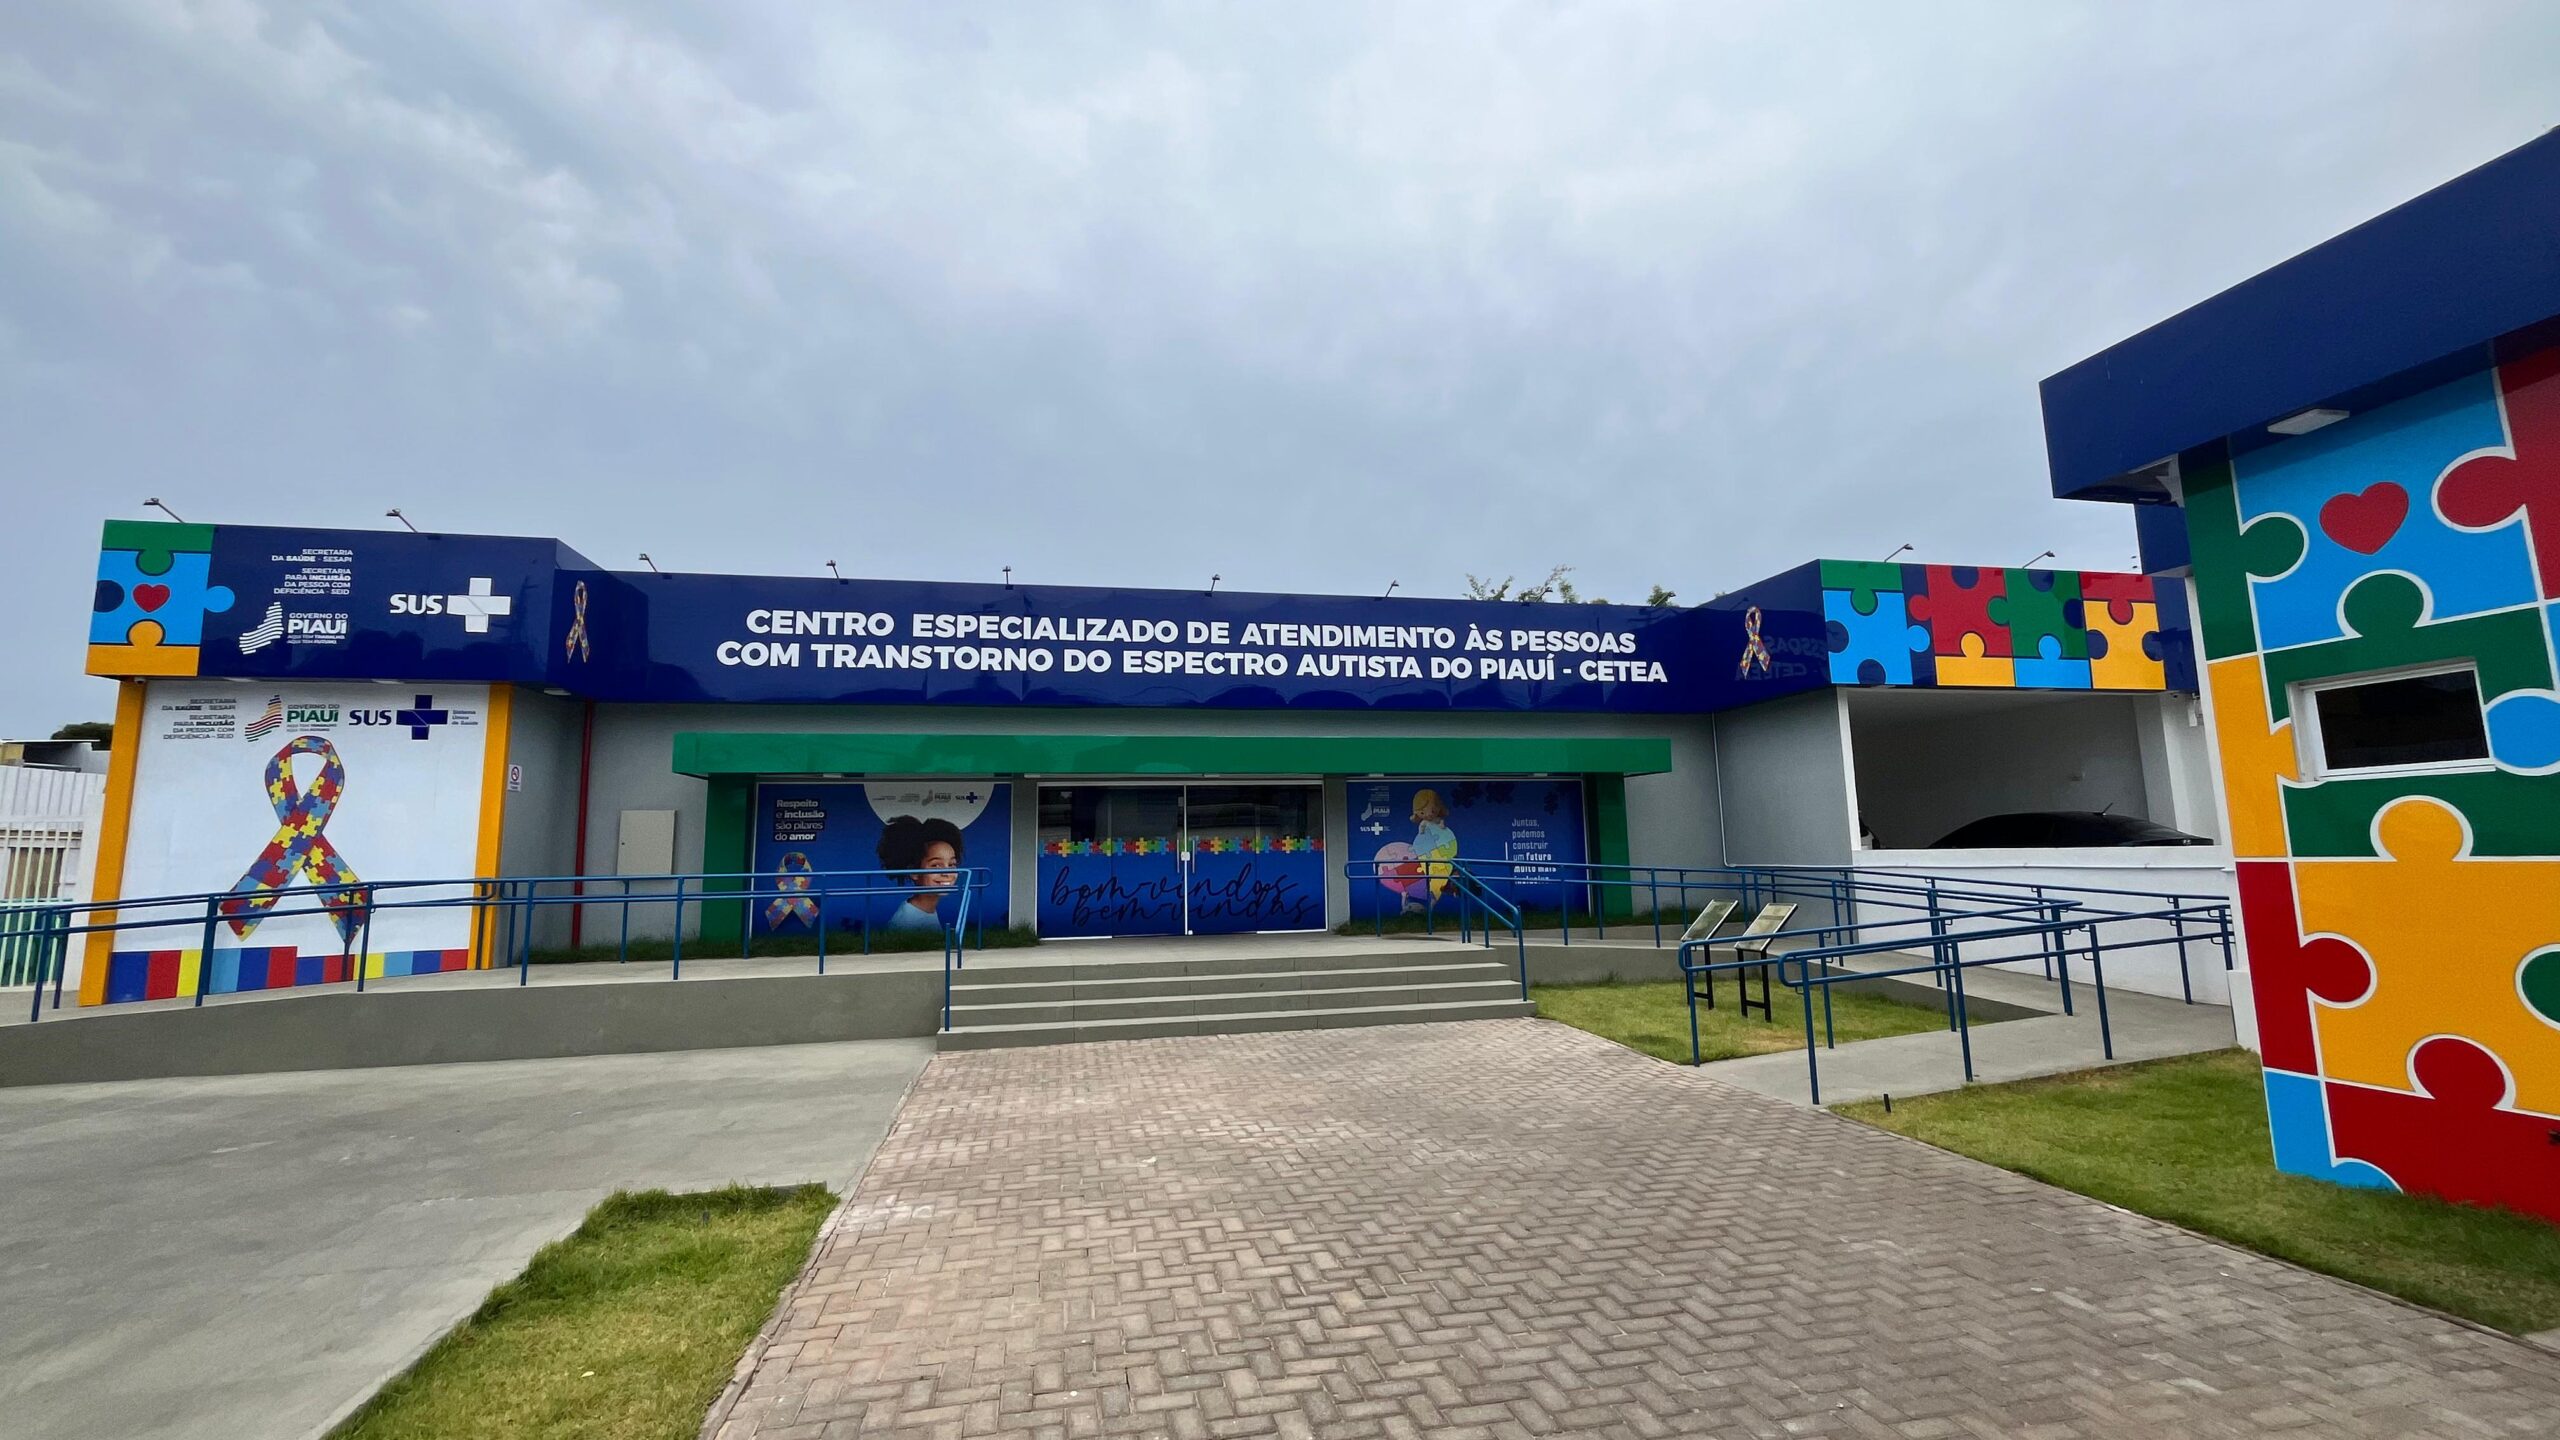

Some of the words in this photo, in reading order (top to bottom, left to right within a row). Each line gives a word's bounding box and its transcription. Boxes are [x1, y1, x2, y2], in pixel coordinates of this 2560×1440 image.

[286, 554, 316, 562] SAÚDE
[309, 573, 351, 581] INCLUSÃO
[389, 594, 443, 615] SUS
[287, 619, 348, 634] PIAUÍ
[746, 610, 895, 638] CENTRO
[913, 614, 1178, 643] ESPECIALIZADO
[1188, 621, 1230, 645] DE
[1240, 622, 1456, 650] ATENDIMENTO
[1465, 623, 1504, 651] ÀS
[1511, 630, 1636, 654] PESSOAS
[716, 640, 800, 669] COM
[811, 644, 1054, 672] TRANSTORNO
[1064, 649, 1111, 673] DO
[1124, 650, 1288, 676] ESPECTRO
[1297, 654, 1423, 679] AUTISTA
[1431, 657, 1473, 680] DO
[1481, 653, 1555, 682] PIAUÍ
[1580, 660, 1668, 683] CETEA
[287, 709, 339, 723] PIAUÍ
[349, 709, 392, 726] SUS
[776, 799, 819, 809] Respeito
[784, 810, 825, 818] inclusão
[775, 821, 792, 829] são
[793, 821, 823, 831] pilares
[775, 832, 788, 840] do
[1512, 830, 1545, 840] podemos
[1512, 841, 1548, 850] construir
[1526, 852, 1552, 861] futuro
